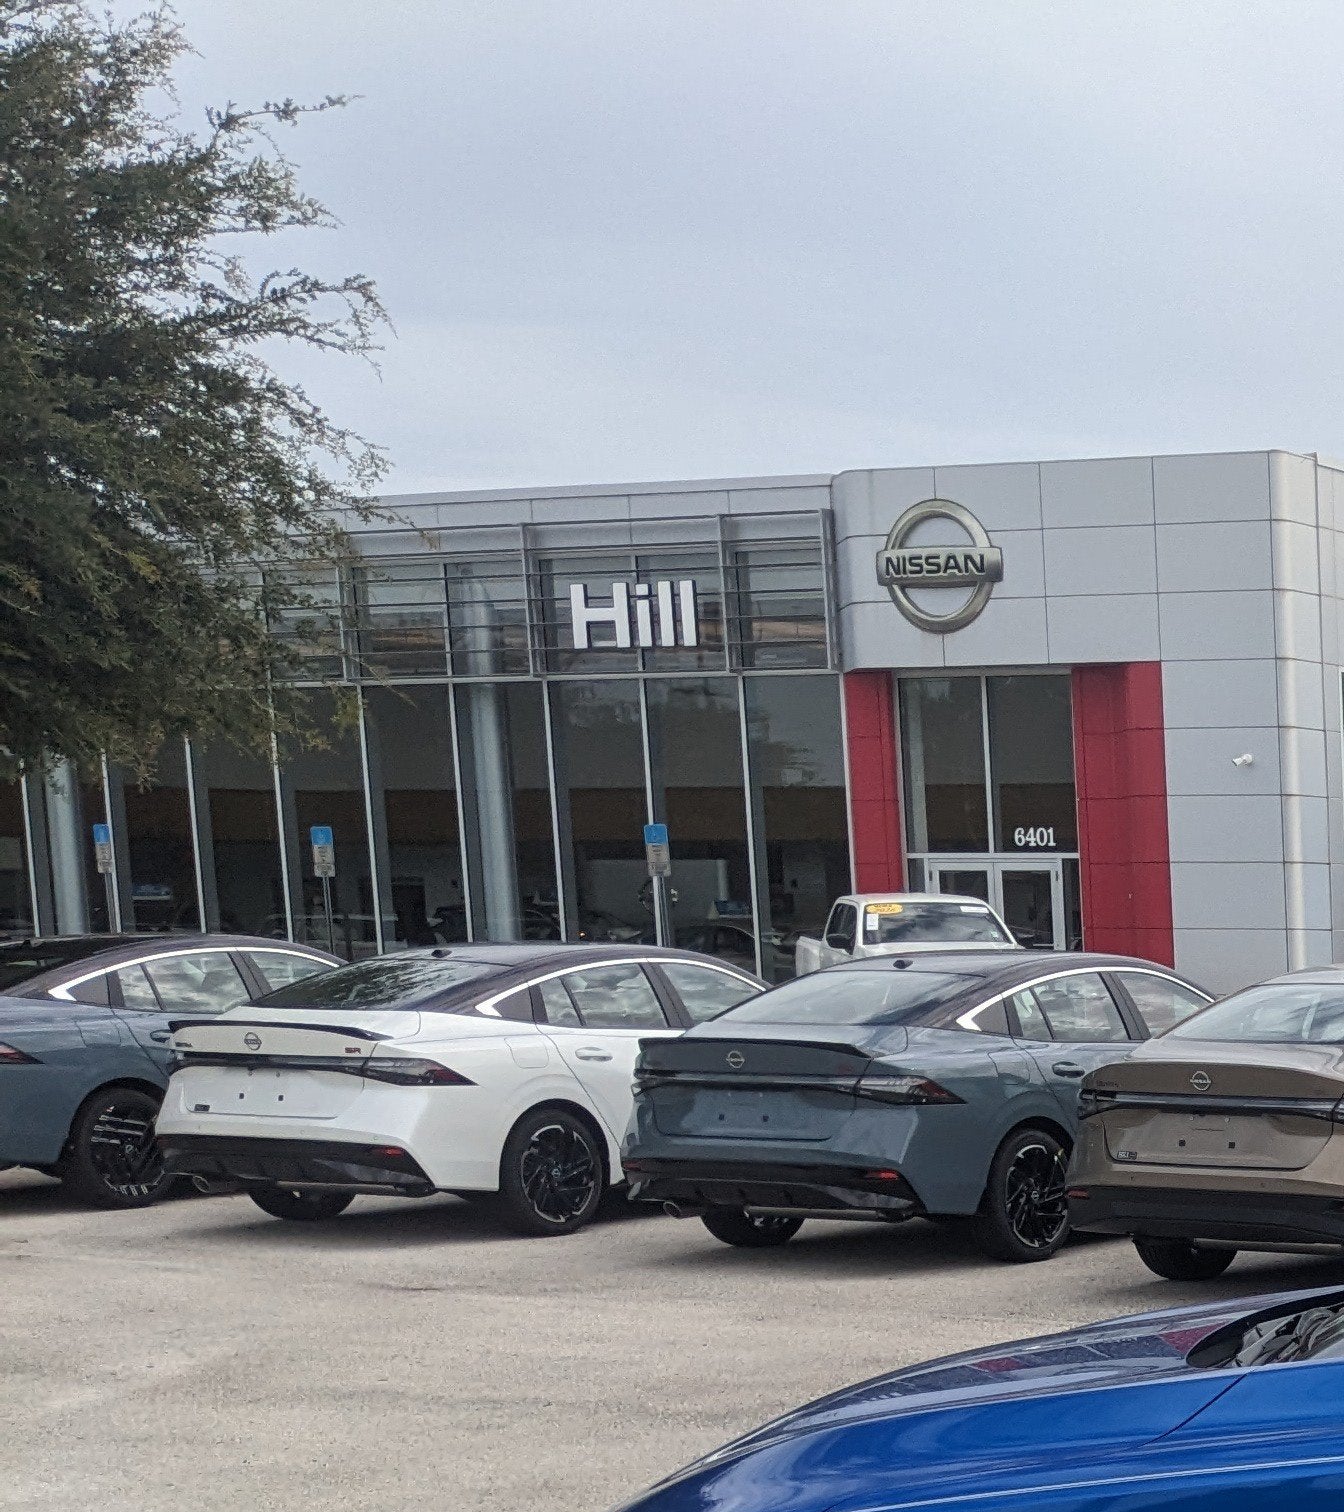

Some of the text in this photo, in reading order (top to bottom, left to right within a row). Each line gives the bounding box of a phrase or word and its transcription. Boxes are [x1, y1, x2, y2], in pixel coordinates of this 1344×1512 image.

[885, 553, 986, 576] NISSAN
[570, 580, 698, 649] Hill
[1014, 827, 1057, 847] 6401
